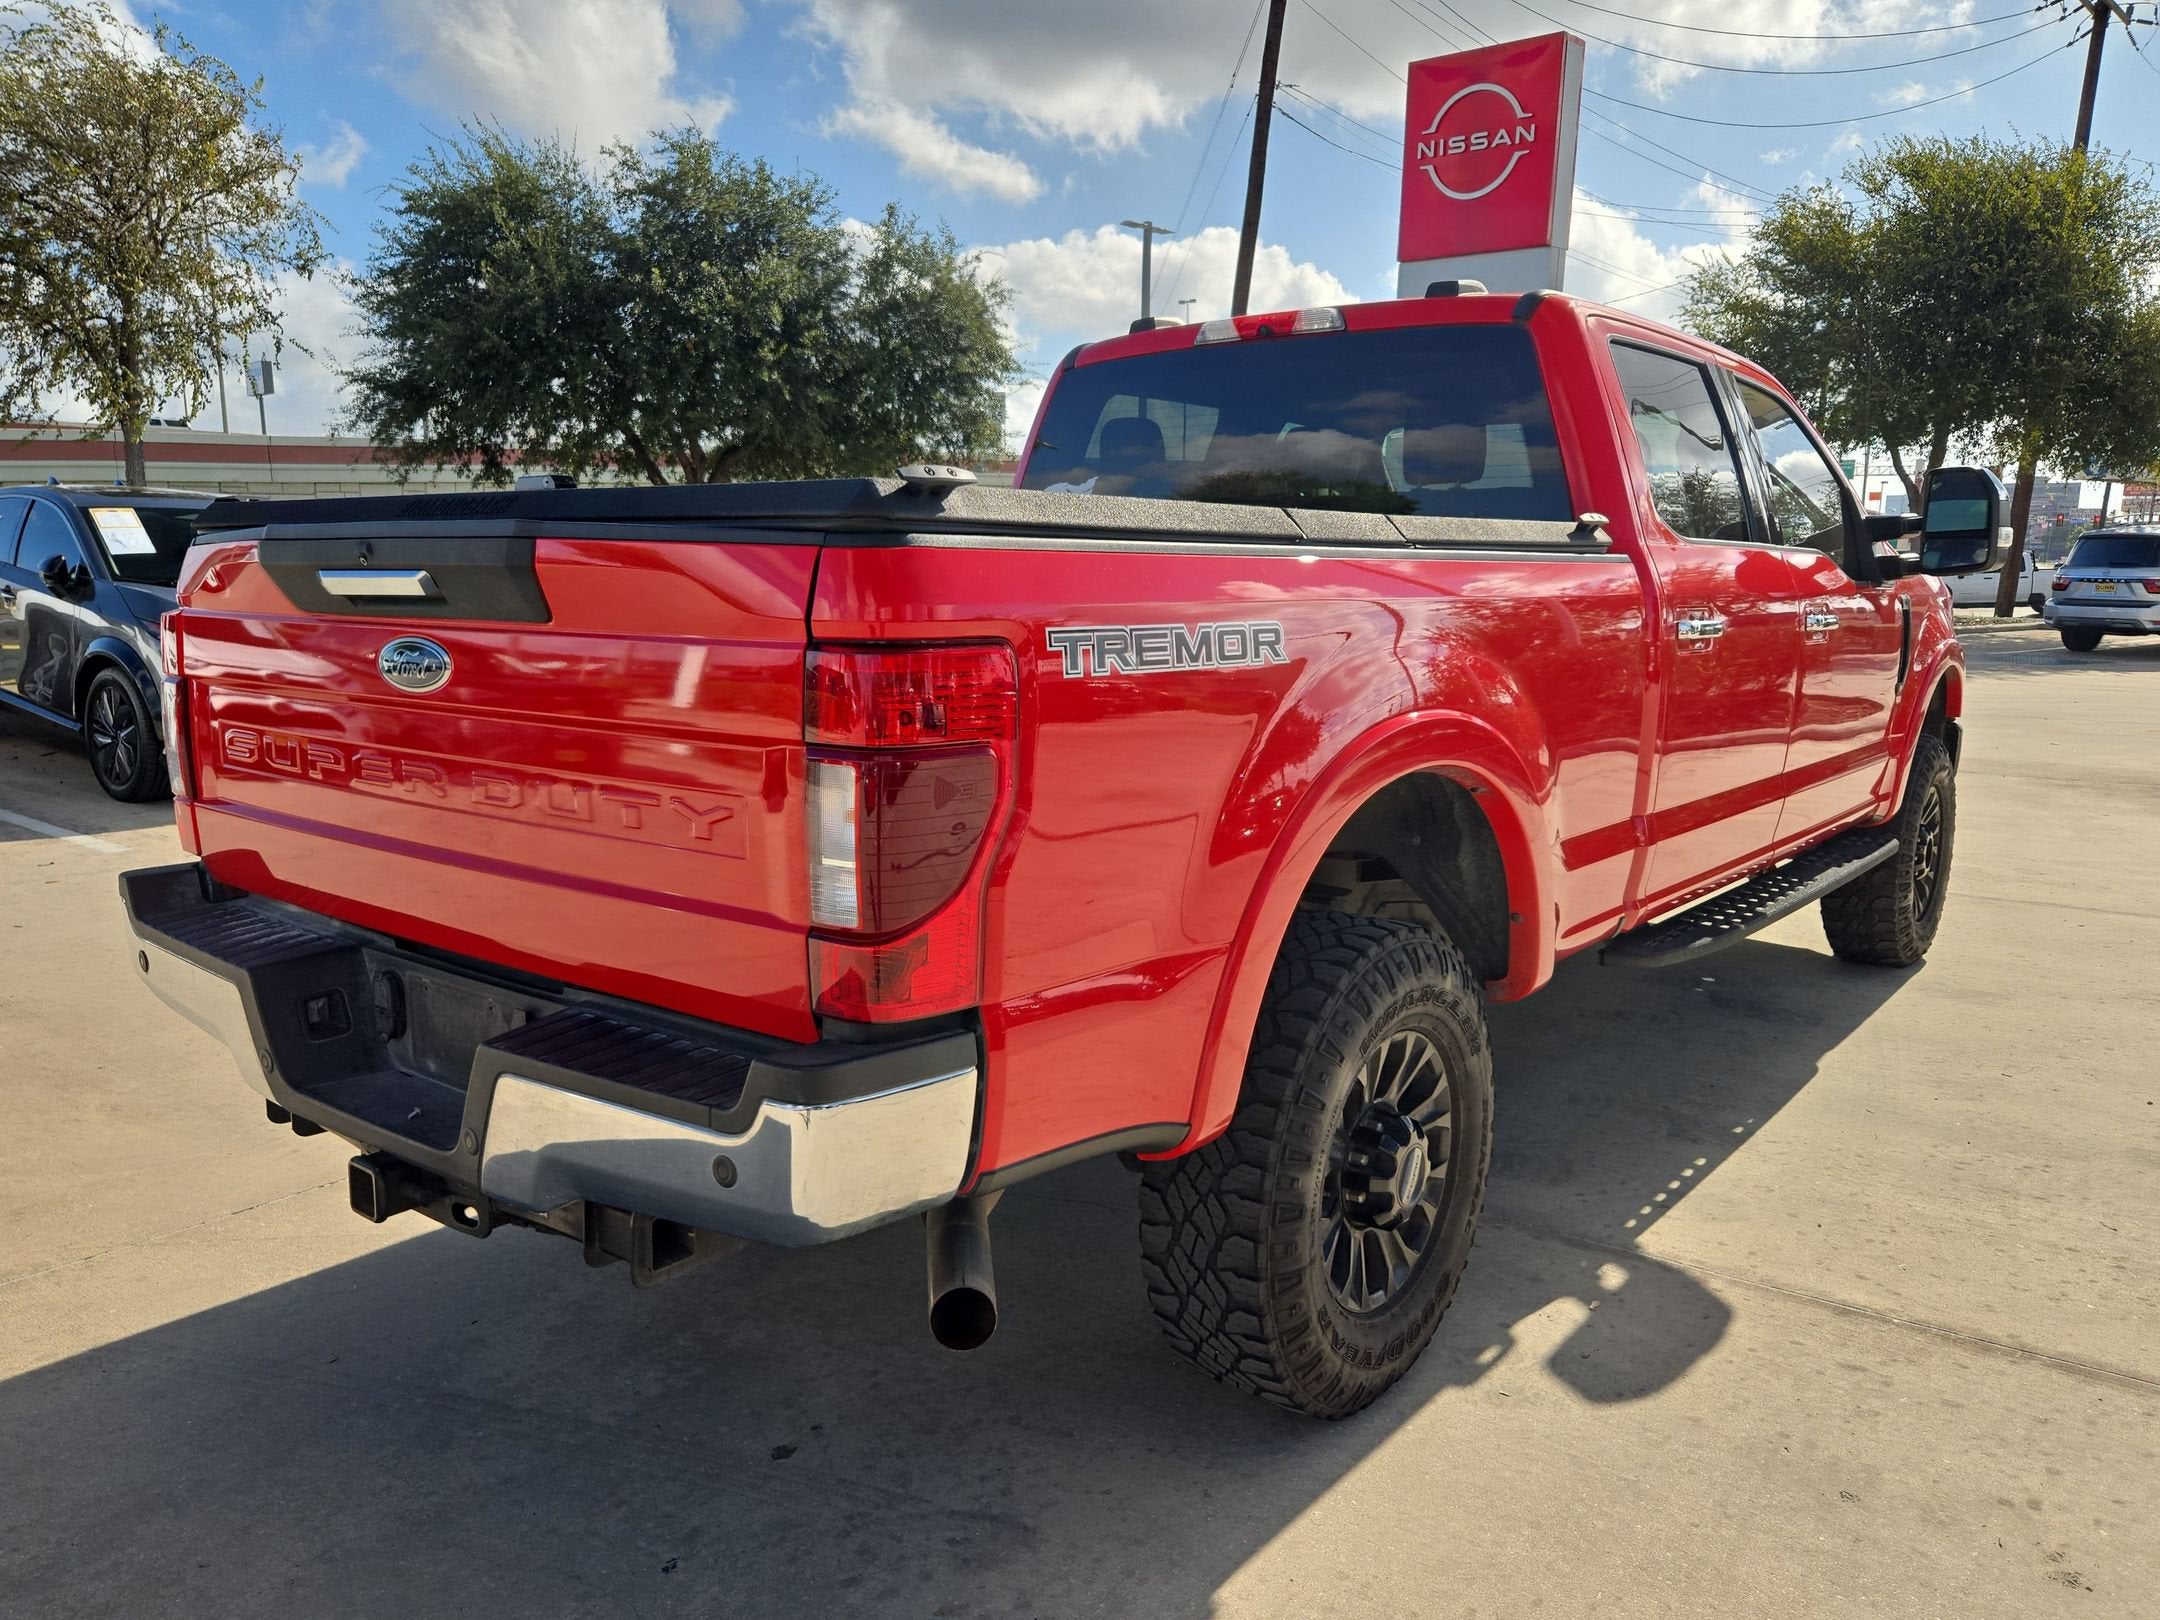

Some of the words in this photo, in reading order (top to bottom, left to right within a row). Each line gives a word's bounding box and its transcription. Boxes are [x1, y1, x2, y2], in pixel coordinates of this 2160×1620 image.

[1416, 123, 1536, 160] NISSAN
[391, 648, 430, 680] Ford
[1045, 620, 1290, 679] TREMOR
[224, 729, 449, 798] SUPER
[472, 771, 735, 841] DUTY
[1360, 984, 1481, 1057] WRANGLER
[1318, 1270, 1451, 1371] GOODYEAR
